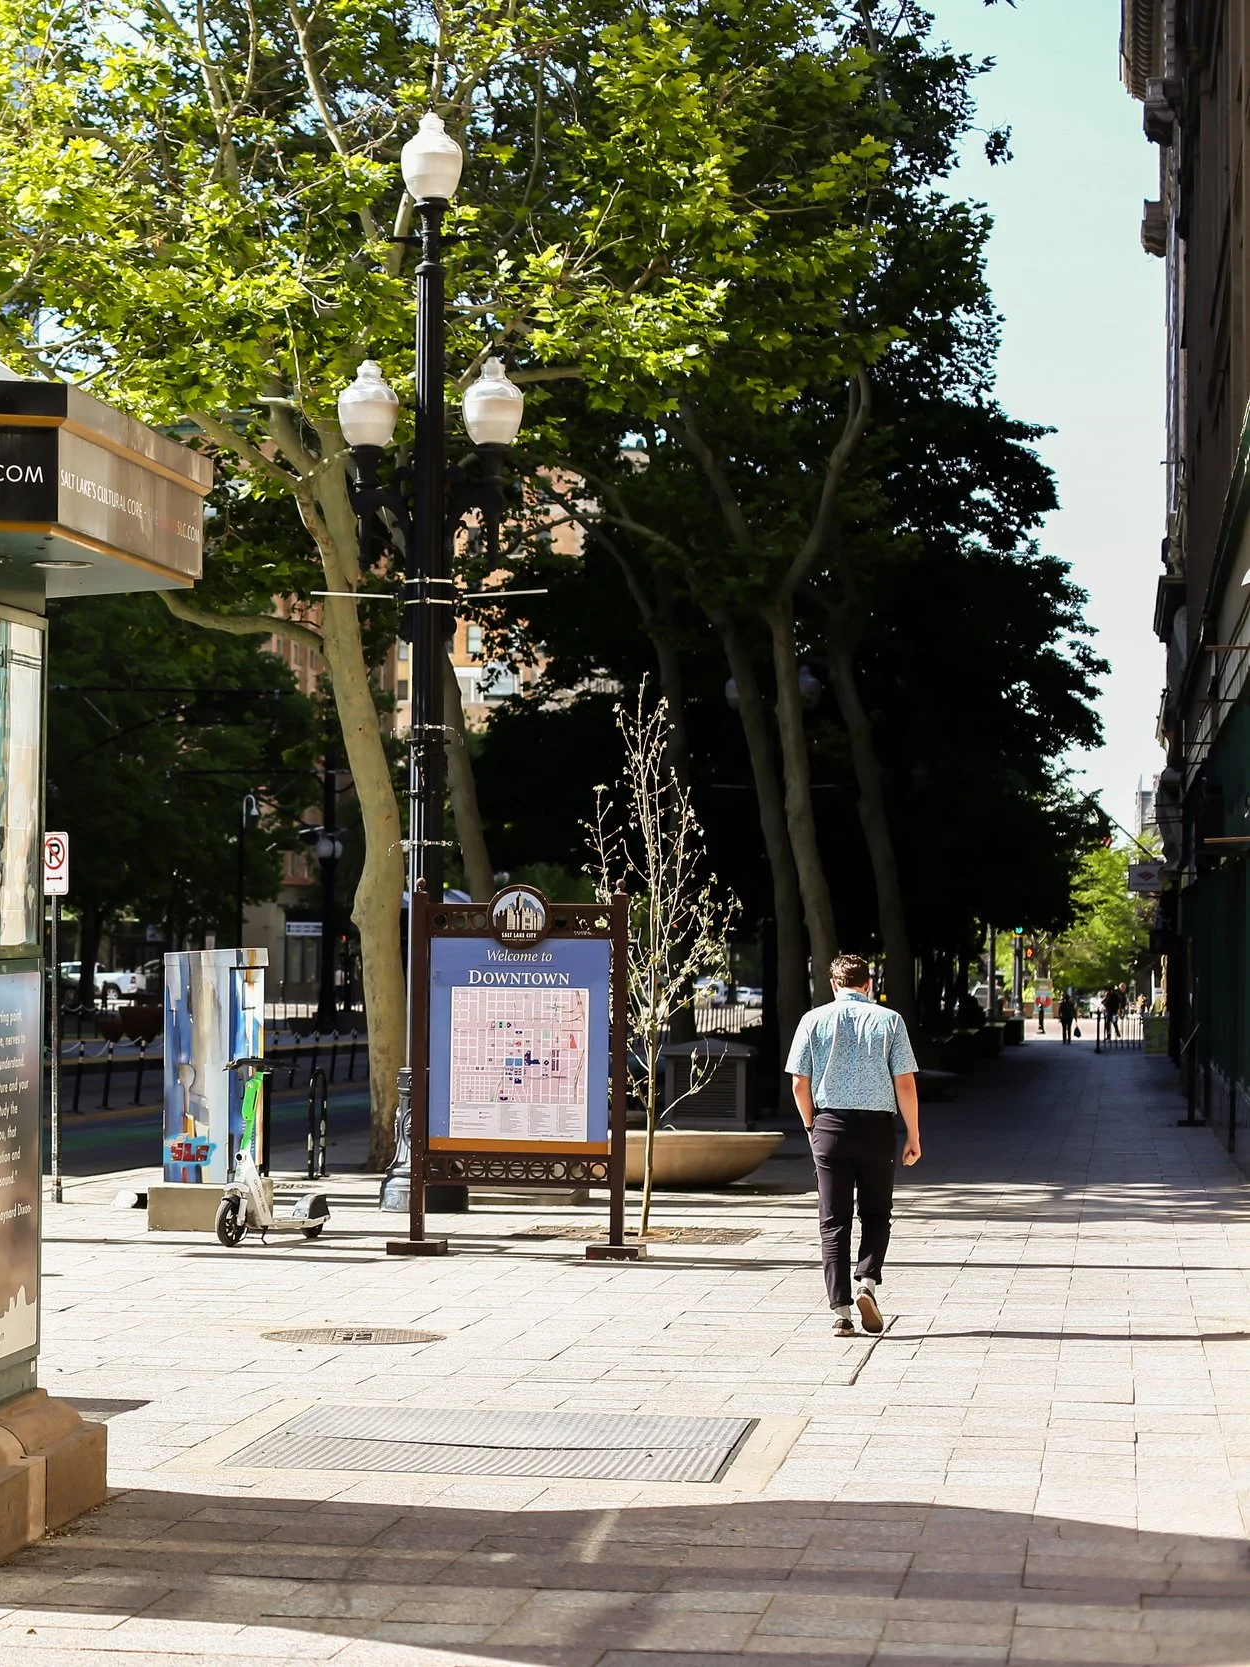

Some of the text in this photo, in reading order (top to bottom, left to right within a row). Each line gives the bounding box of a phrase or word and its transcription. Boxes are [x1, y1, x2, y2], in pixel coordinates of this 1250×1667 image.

[61, 469, 143, 519] SALT LAKE'S CULTURAL CORE
[487, 949, 552, 962] Welcome to
[6, 1035, 20, 1045] nerves
[21, 1032, 25, 1043] to
[0, 1053, 25, 1070] understand.
[9, 1077, 18, 1092] and
[19, 1080, 29, 1094] your
[10, 1101, 18, 1114] the
[7, 1124, 17, 1139] that
[11, 1145, 21, 1160] and
